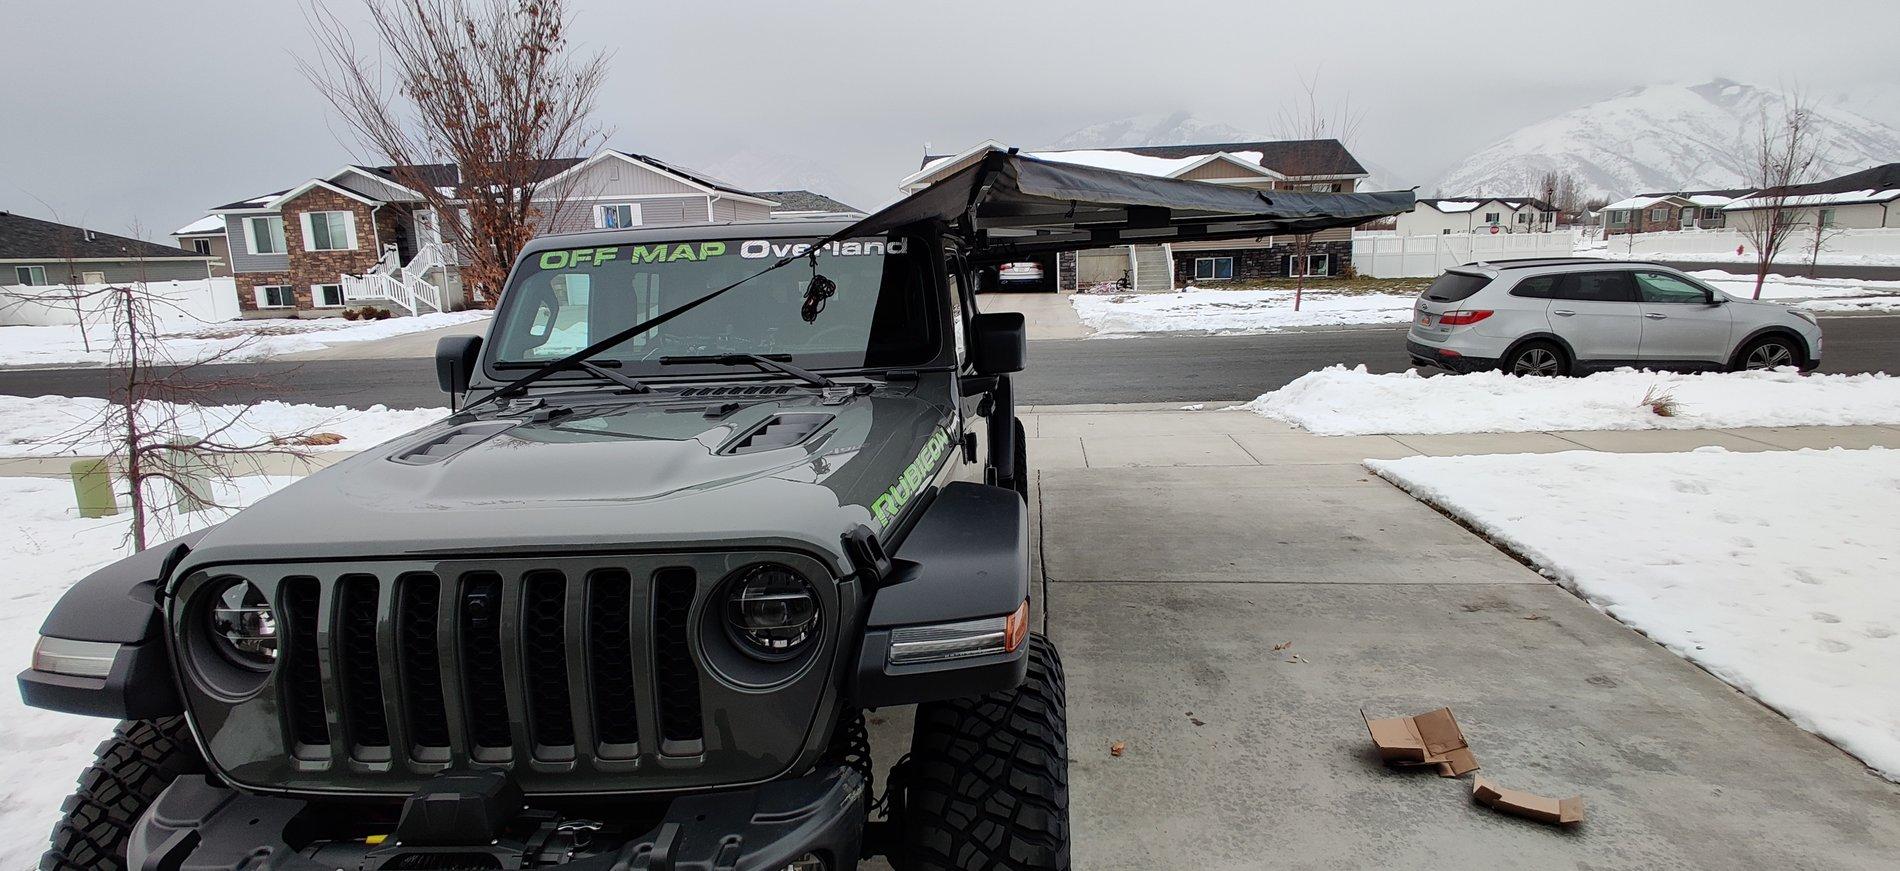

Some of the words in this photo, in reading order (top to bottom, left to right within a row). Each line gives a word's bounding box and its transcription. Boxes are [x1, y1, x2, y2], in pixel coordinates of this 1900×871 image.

[539, 247, 619, 270] OFF
[631, 241, 726, 265] MAP
[870, 426, 949, 528] RUBICON
